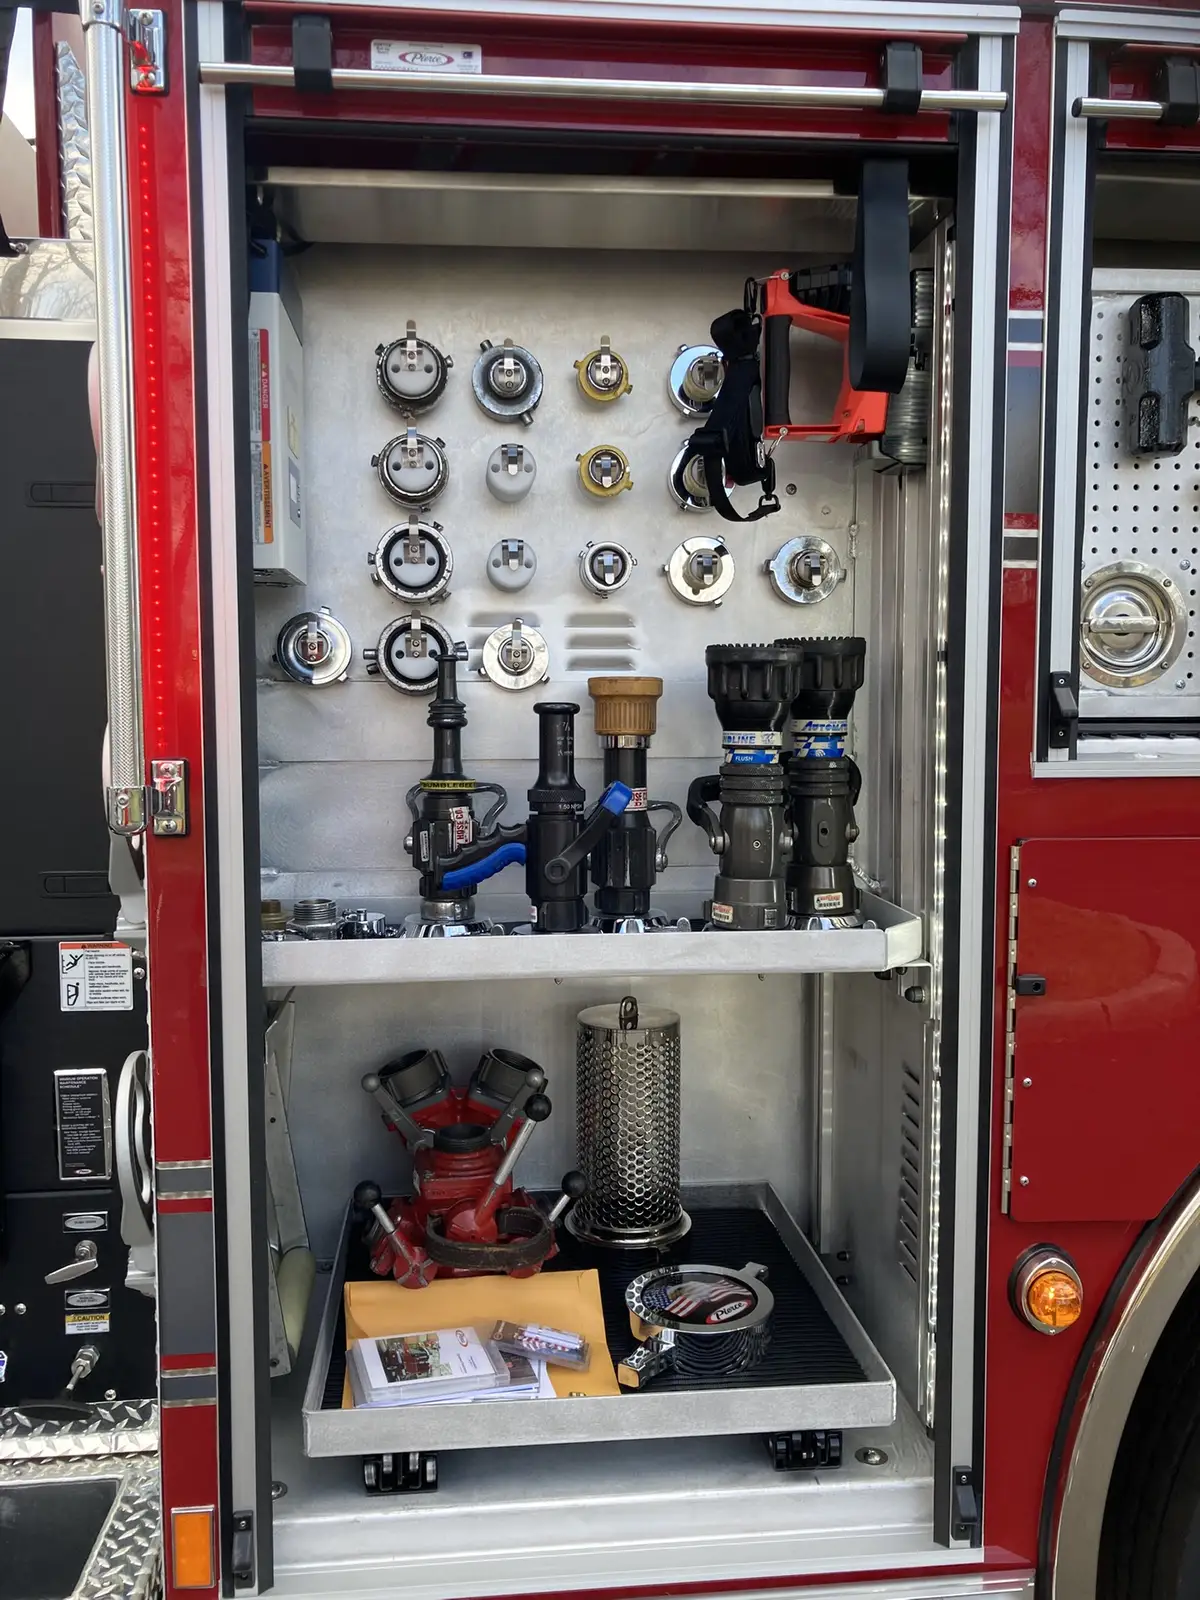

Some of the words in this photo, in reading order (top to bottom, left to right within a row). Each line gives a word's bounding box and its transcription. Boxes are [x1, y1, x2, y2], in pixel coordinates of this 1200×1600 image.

[411, 52, 441, 63] Pierce
[263, 470, 272, 529] AVERTISSEMENT
[456, 820, 465, 841] HOSE
[714, 1302, 745, 1320] Pierce
